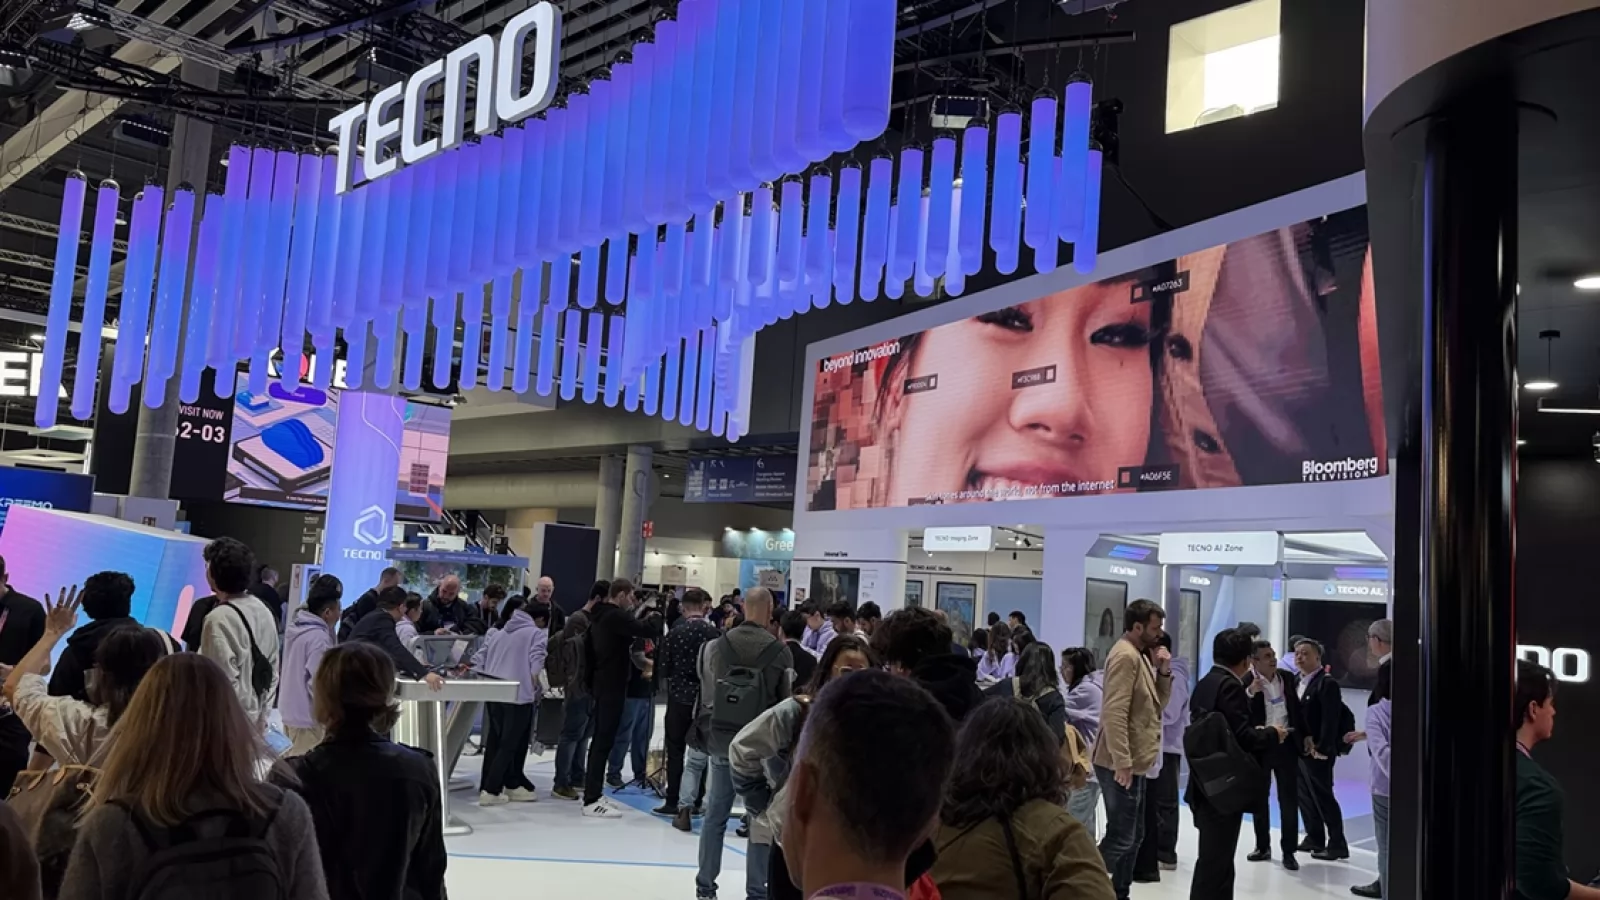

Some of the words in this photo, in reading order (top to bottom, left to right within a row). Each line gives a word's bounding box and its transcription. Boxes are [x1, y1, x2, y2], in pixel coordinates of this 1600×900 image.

[329, 1, 562, 195] TECNO
[823, 352, 854, 373] beyond
[855, 341, 900, 364] innovation
[179, 404, 200, 417] VISIT
[202, 407, 224, 420] NOW
[1302, 456, 1378, 474] Bloomberg
[1302, 470, 1369, 482] TELEVISION
[1025, 486, 1037, 495] not
[1040, 483, 1059, 494] from
[1061, 481, 1076, 492] the
[1077, 480, 1114, 491] internet
[343, 548, 381, 560] TECNO
[1187, 543, 1212, 552] TECNO
[1214, 543, 1223, 552] AI
[1224, 543, 1244, 552] Zone
[1337, 585, 1369, 596] TECNO
